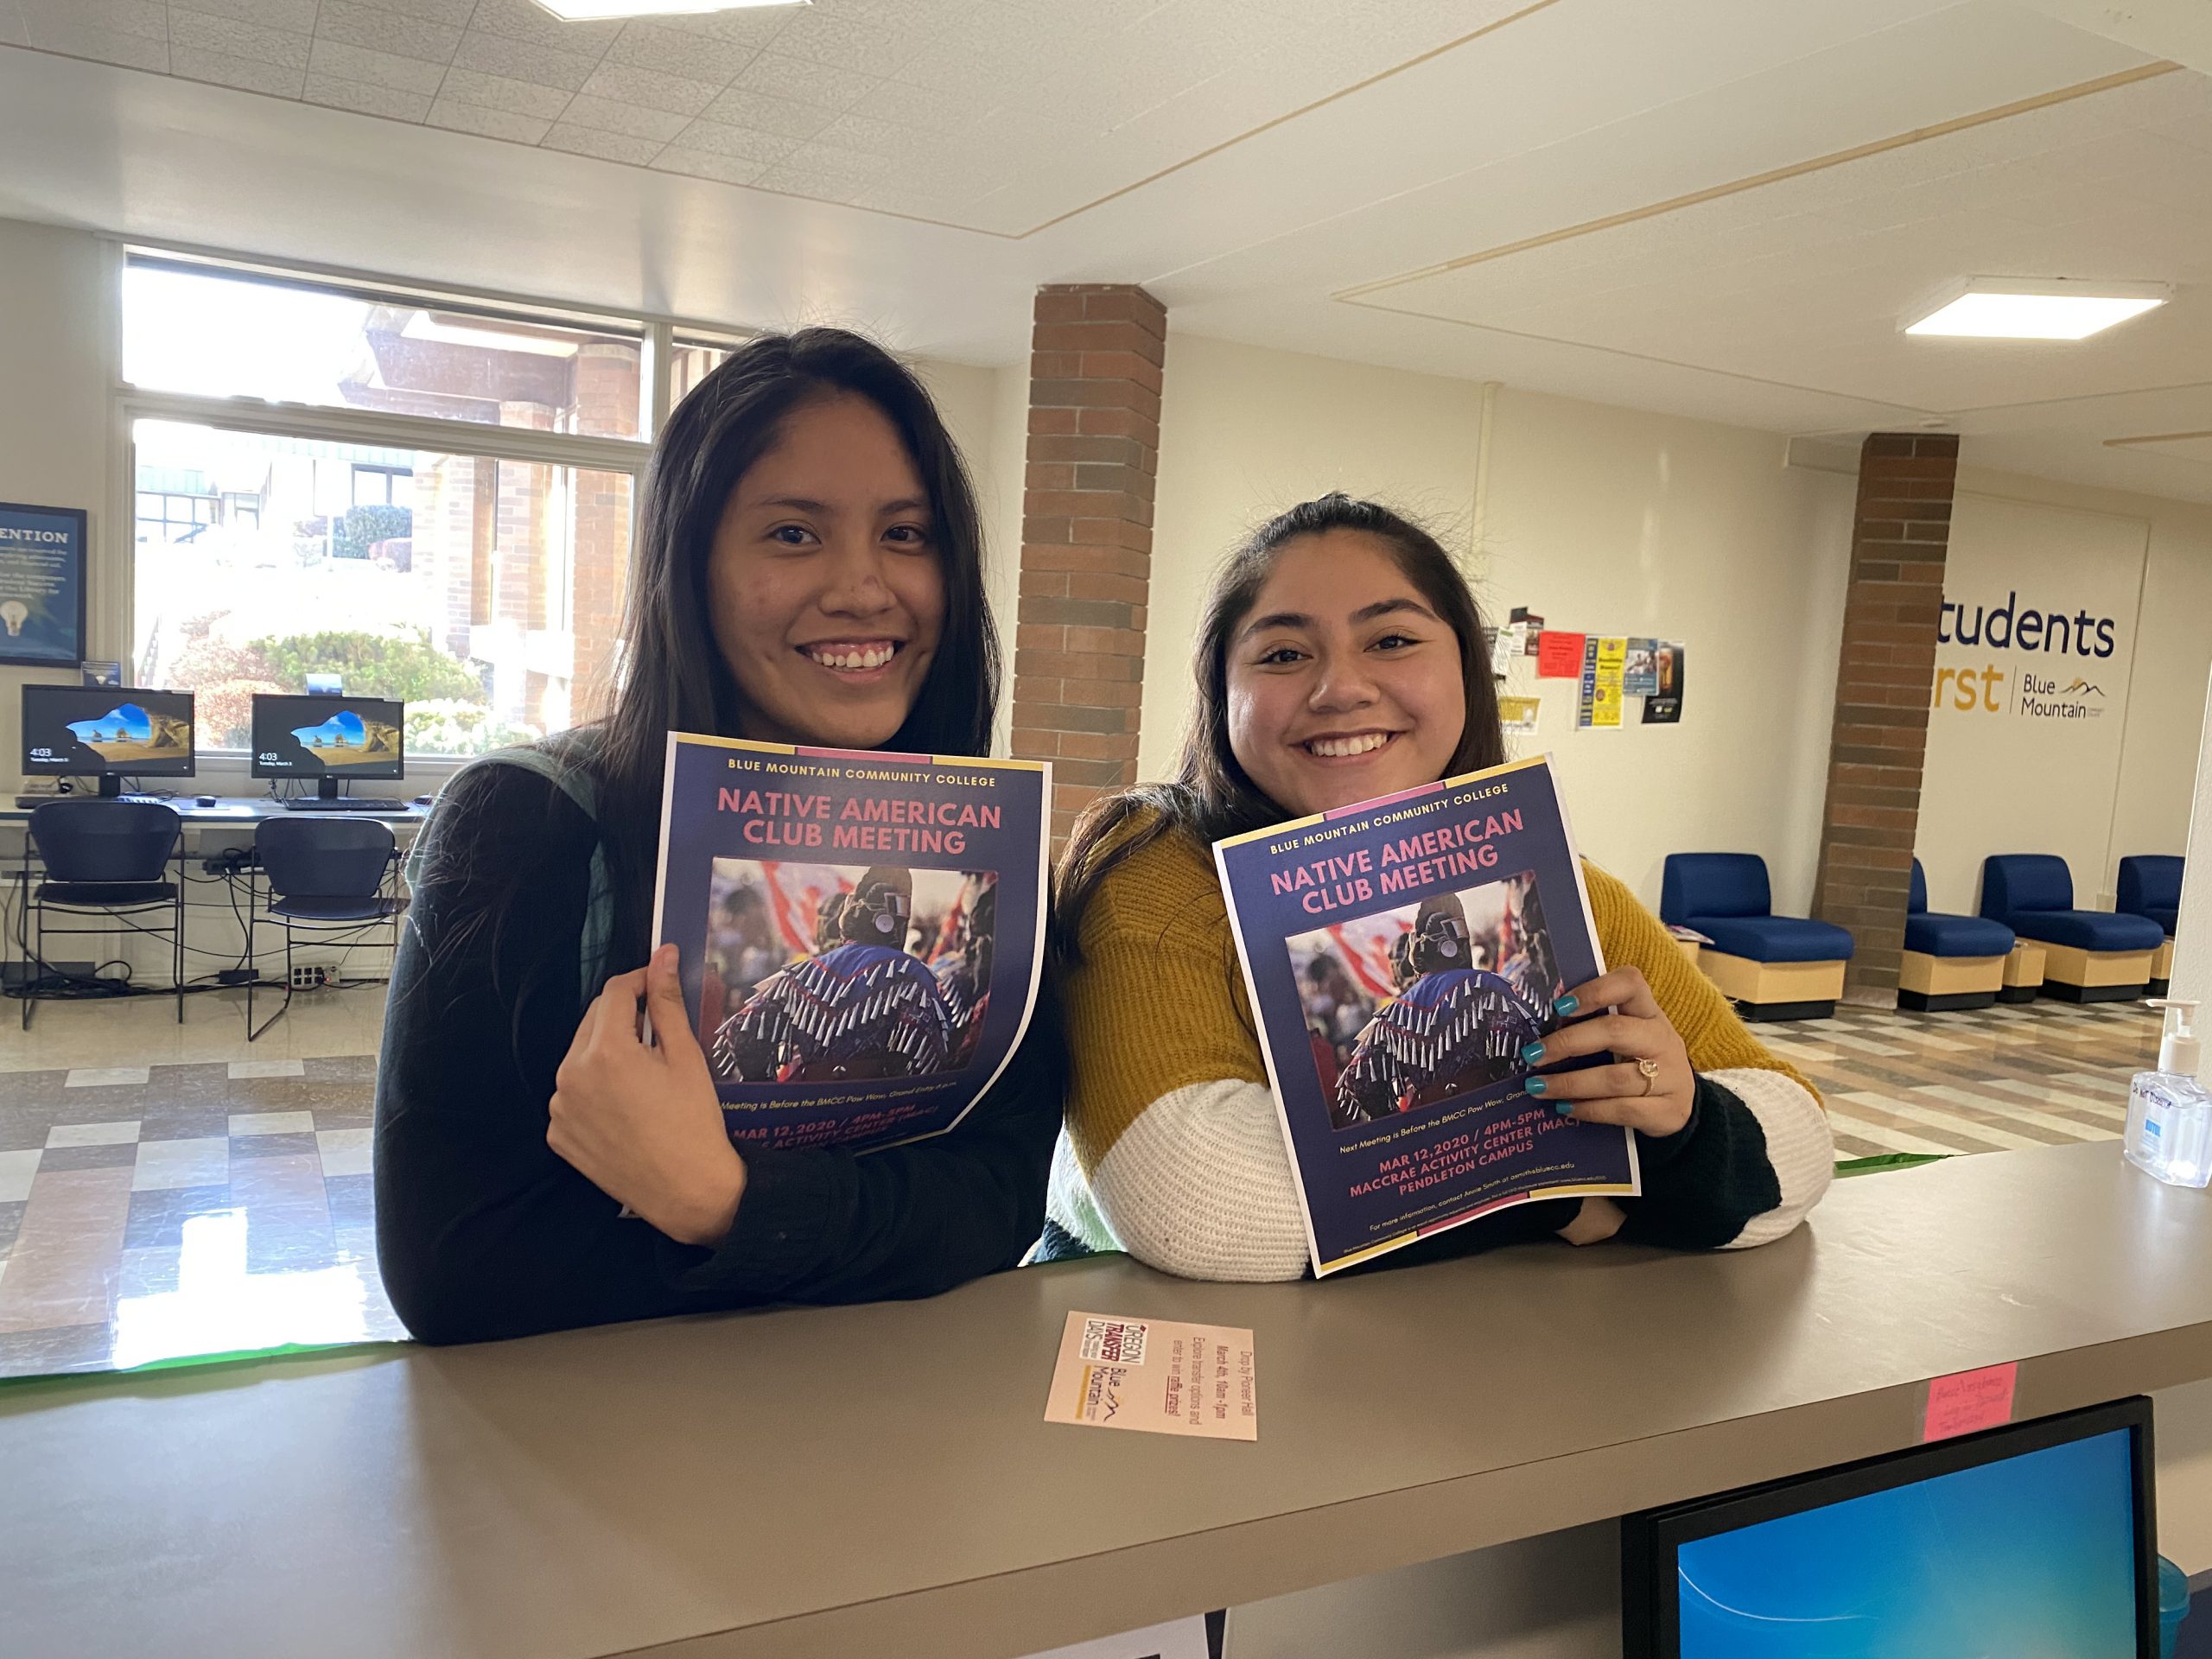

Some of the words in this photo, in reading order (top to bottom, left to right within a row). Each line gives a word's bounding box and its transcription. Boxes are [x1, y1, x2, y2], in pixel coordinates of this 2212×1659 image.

[1934, 664, 2004, 712] rst
[2023, 673, 2056, 695] Blue
[2020, 697, 2087, 719] Mountain
[259, 753, 277, 761] 4:03
[728, 759, 761, 771] BLUE
[766, 763, 840, 778] MOUNTAIN
[845, 769, 931, 783] COMMUNITY
[936, 774, 995, 787] COLLEGE
[718, 787, 830, 819] NATIVE
[840, 798, 1001, 829] AMERICAN
[1270, 839, 1300, 855] BLUE
[1303, 821, 1370, 846] MOUNTAIN
[1373, 798, 1449, 827] COMMUNITY
[1453, 784, 1509, 805] COLLEGE
[743, 819, 822, 847] CLUB
[832, 825, 966, 855] MEETING
[1270, 849, 1372, 895] NATIVE
[1380, 808, 1523, 868] AMERICAN
[1302, 878, 1373, 913] CLUB
[1380, 844, 1498, 895] MEETING
[769, 1100, 798, 1109] Before
[817, 1096, 846, 1106] BMCC
[734, 1128, 767, 1139] MAR
[1340, 1143, 1357, 1154] Next
[1359, 1135, 1391, 1149] Meeting
[1393, 1130, 1400, 1139] is
[1401, 1125, 1426, 1137] Before
[1427, 1119, 1440, 1128] the
[1441, 1109, 1466, 1123] BMCC
[1467, 1104, 1484, 1115] Pow
[1379, 1154, 1410, 1173] MAR
[1484, 1108, 1546, 1136] 4PM-5PM
[1350, 1167, 1417, 1198] MACCRAE
[1421, 1144, 1479, 1174] ACTIVITY
[1483, 1126, 1533, 1150] CENTER
[1537, 1115, 1580, 1136] (MAC)
[1399, 1160, 1476, 1196] PENDLETON
[1478, 1140, 1535, 1166] CAMPUS
[1382, 1218, 1399, 1227] more
[1438, 1193, 1463, 1207] contact
[1464, 1186, 1482, 1198] Annie
[1483, 1179, 1501, 1190] Smith
[1086, 1320, 1105, 1339] DAYS
[1101, 1323, 1124, 1362] TRANSFER
[1173, 1340, 1184, 1356] enter
[1191, 1337, 1205, 1359] Explore
[1217, 1344, 1229, 1364] March
[1109, 1368, 1127, 1387] Blue
[1172, 1364, 1183, 1375] win
[1192, 1360, 1205, 1384] transfer
[1087, 1365, 1109, 1405] Mountain
[1189, 1385, 1203, 1409] options
[1189, 1410, 1202, 1425] and
